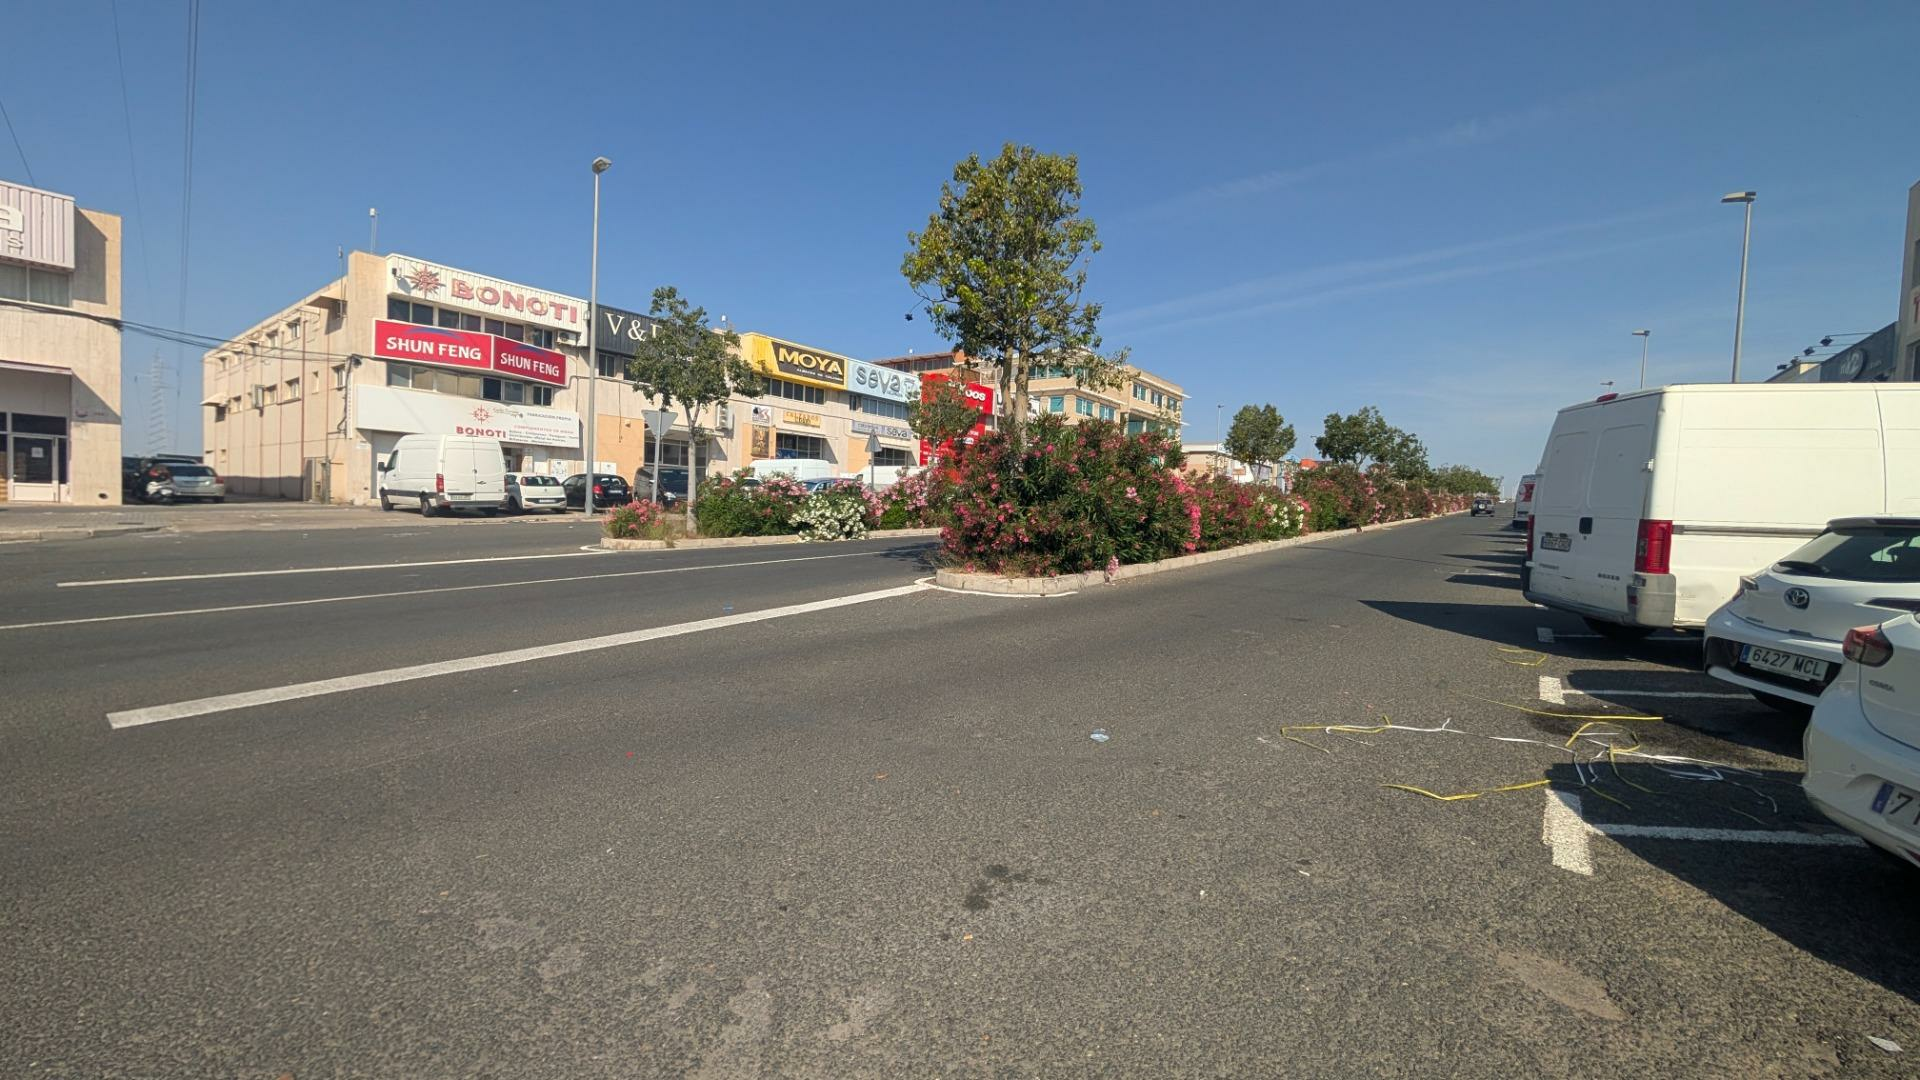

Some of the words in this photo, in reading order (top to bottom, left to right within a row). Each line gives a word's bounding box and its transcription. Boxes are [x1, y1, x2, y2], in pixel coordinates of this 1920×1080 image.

[451, 278, 578, 323] BONOTI
[605, 312, 625, 336] V
[628, 319, 647, 341] &
[386, 336, 434, 355] SHUN
[438, 343, 482, 360] FENG
[778, 347, 843, 376] MOYA
[500, 352, 531, 371] SHUN
[533, 360, 560, 377] FENG
[456, 426, 507, 439] BONOTI
[1752, 649, 1791, 668] 6427
[1793, 656, 1821, 677] MCL
